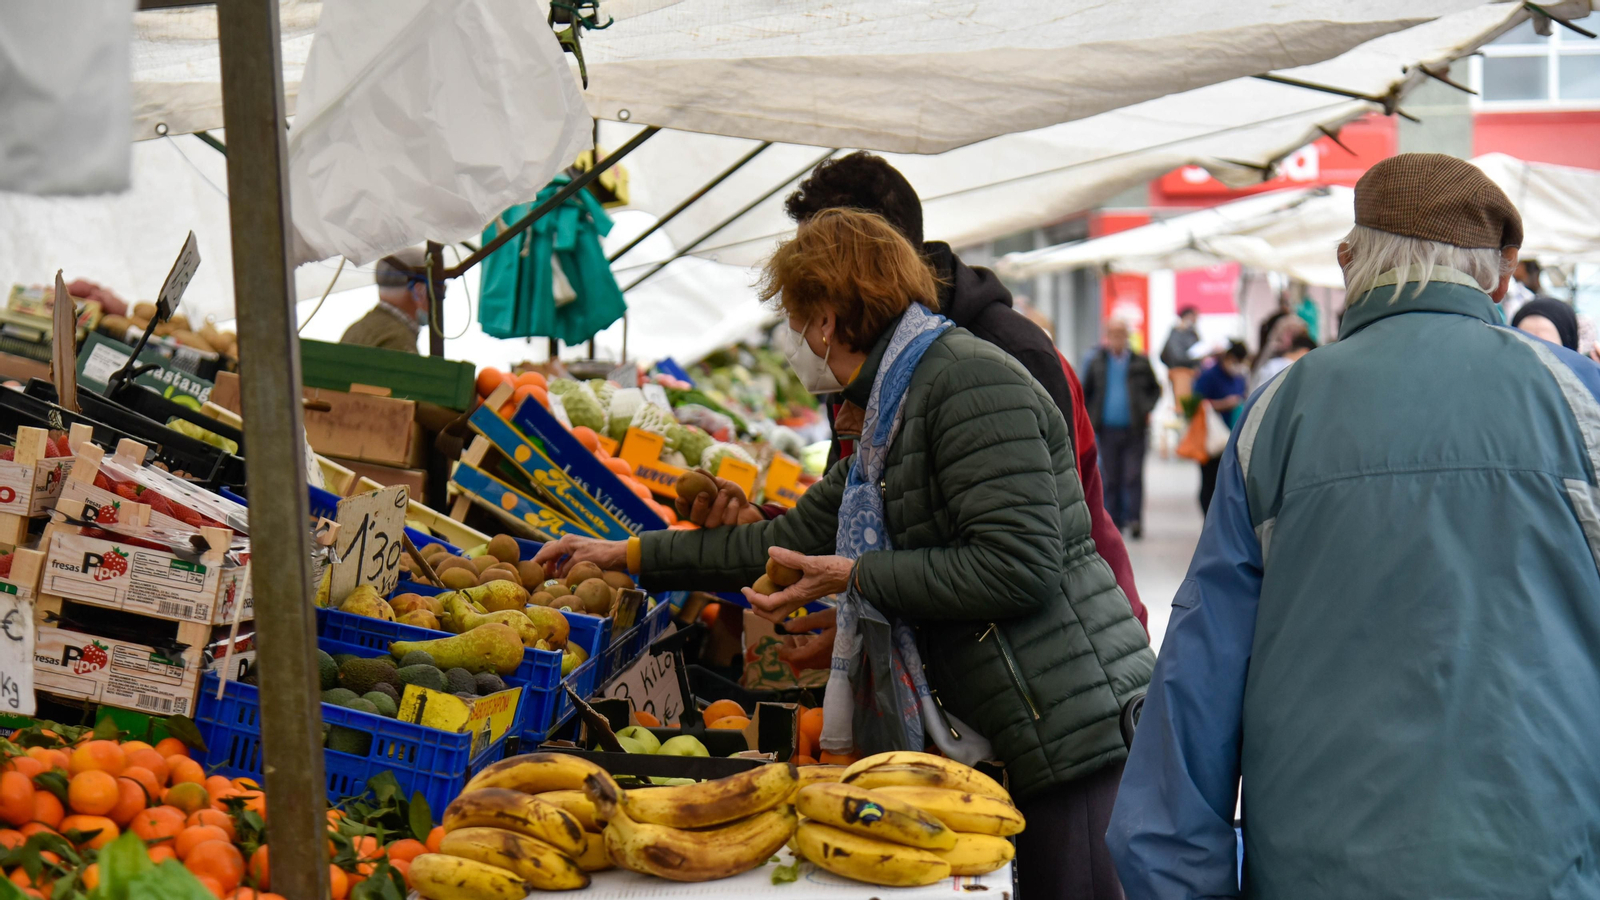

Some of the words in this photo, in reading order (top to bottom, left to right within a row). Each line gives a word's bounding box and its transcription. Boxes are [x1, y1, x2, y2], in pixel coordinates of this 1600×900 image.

[52, 559, 80, 572] fresas
[81, 552, 120, 580] Pipo
[61, 645, 100, 674] Pipo
